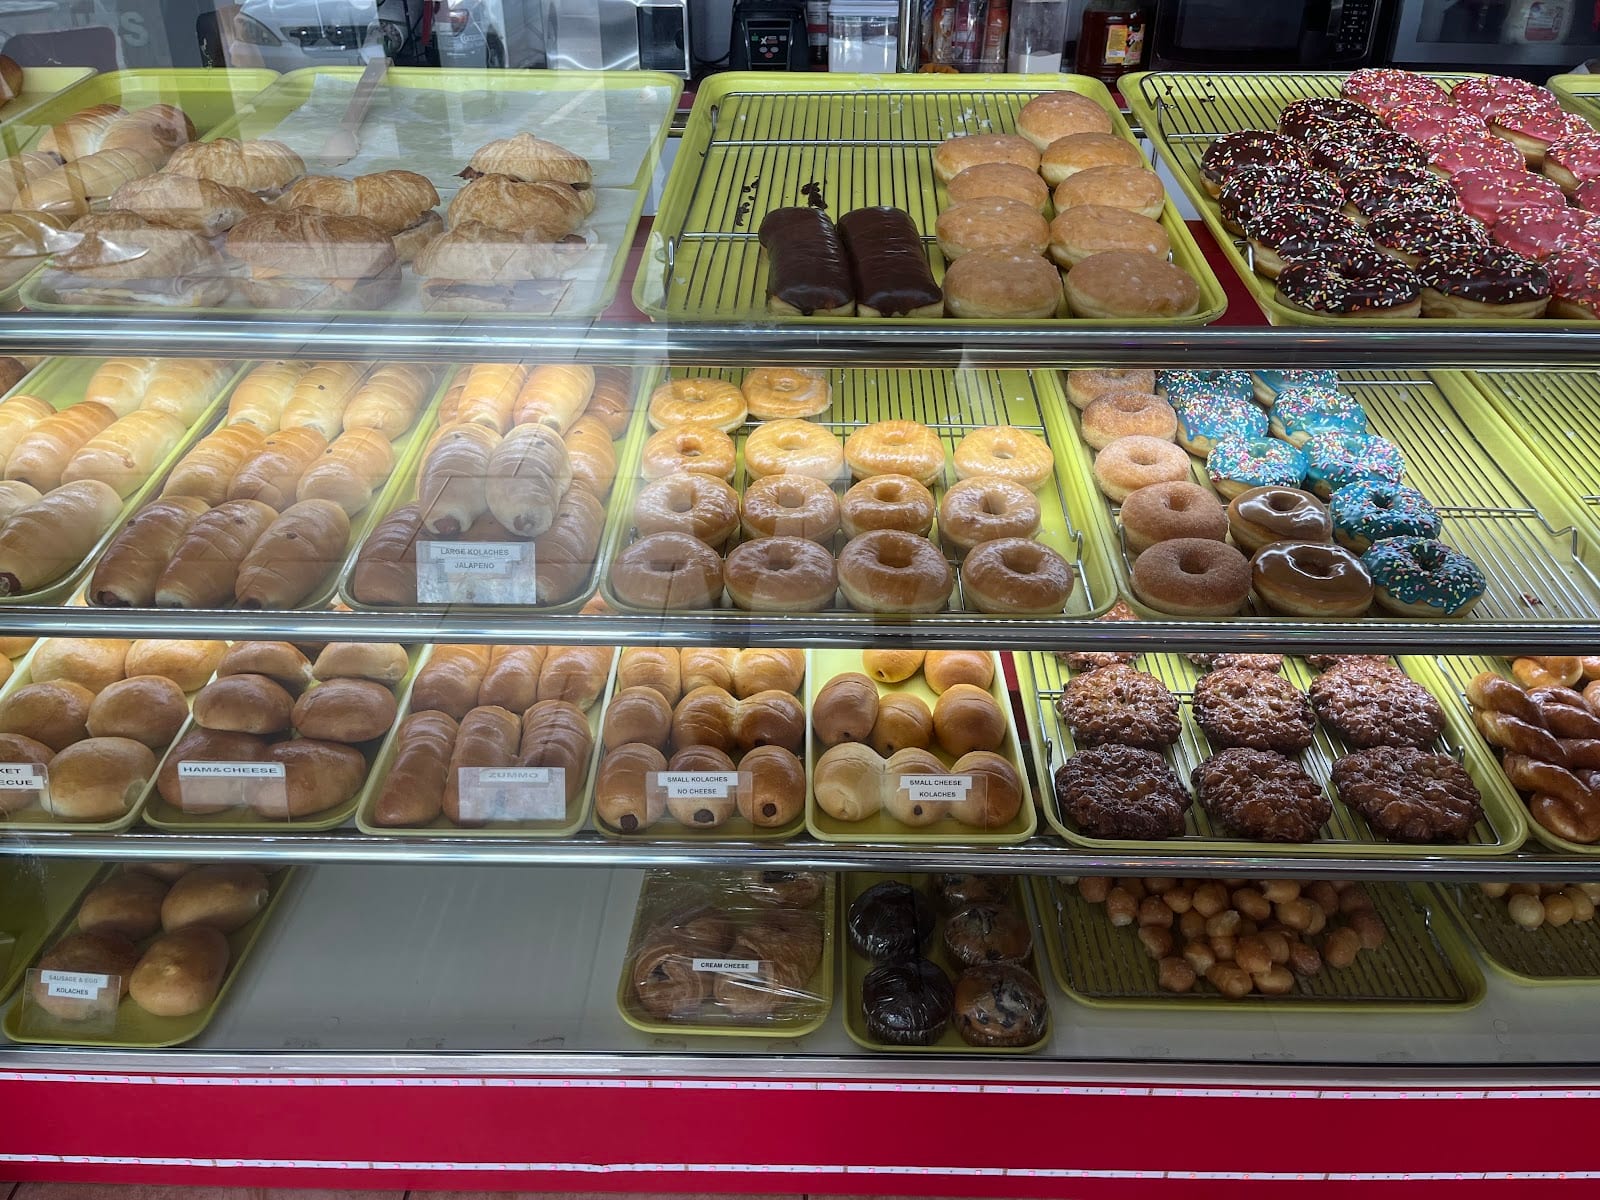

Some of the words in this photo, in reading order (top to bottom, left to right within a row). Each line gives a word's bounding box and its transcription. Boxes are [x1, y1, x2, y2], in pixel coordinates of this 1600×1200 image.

[440, 547, 466, 555] LARGE
[467, 548, 510, 556] KOLACHES
[454, 561, 495, 569] JALAPENO
[49, 974, 77, 983] SAUSAGE
[56, 986, 89, 996] KOLACHES
